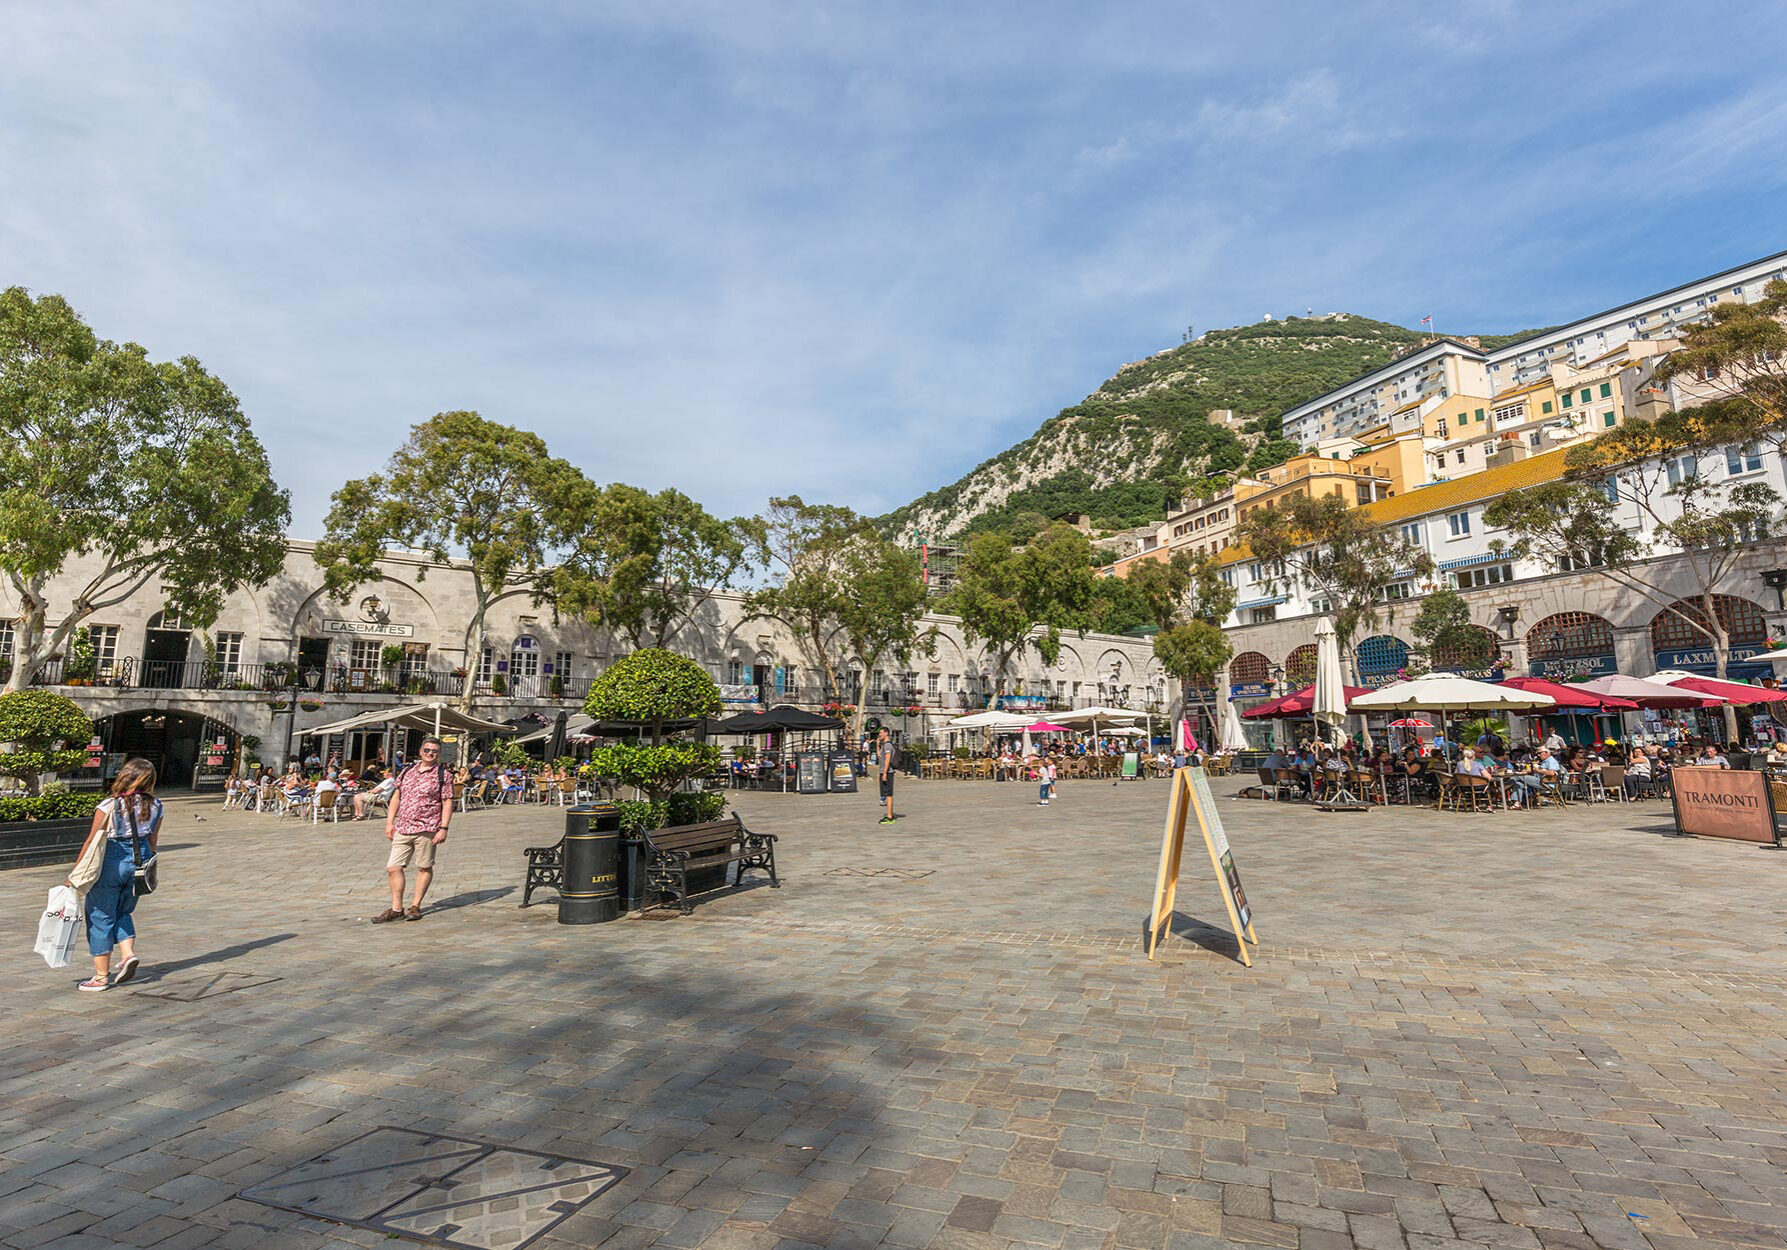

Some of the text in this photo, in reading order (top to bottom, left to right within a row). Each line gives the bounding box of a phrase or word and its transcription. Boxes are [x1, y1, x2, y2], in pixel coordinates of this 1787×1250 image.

[330, 622, 406, 635] CASEMATES
[1673, 649, 1756, 665] LAXM LTD
[1684, 791, 1759, 808] TRAMONTI
